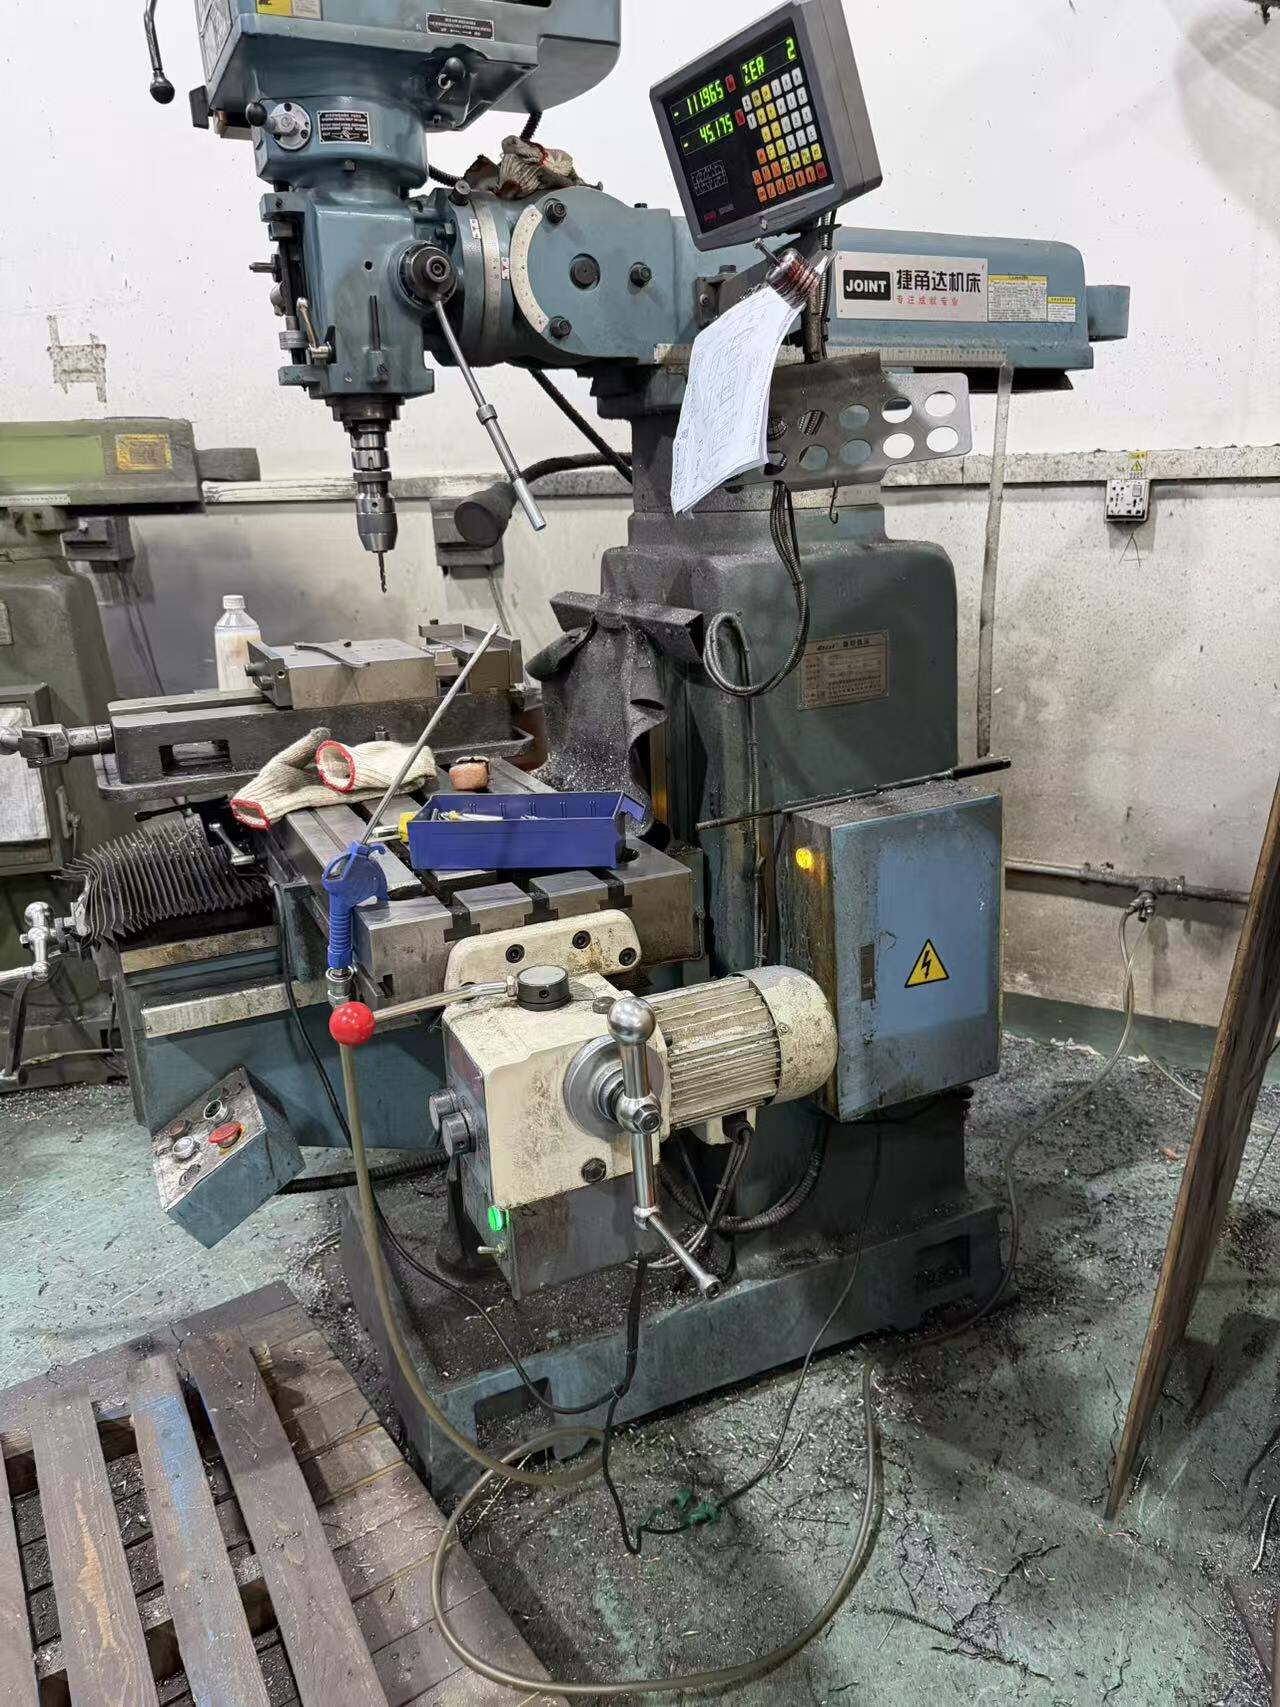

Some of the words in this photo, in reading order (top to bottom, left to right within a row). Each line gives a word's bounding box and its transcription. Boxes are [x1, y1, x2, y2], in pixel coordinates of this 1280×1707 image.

[785, 37, 796, 60] 2
[845, 279, 887, 293] JOINT
[896, 269, 981, 293] 捷甬达机床
